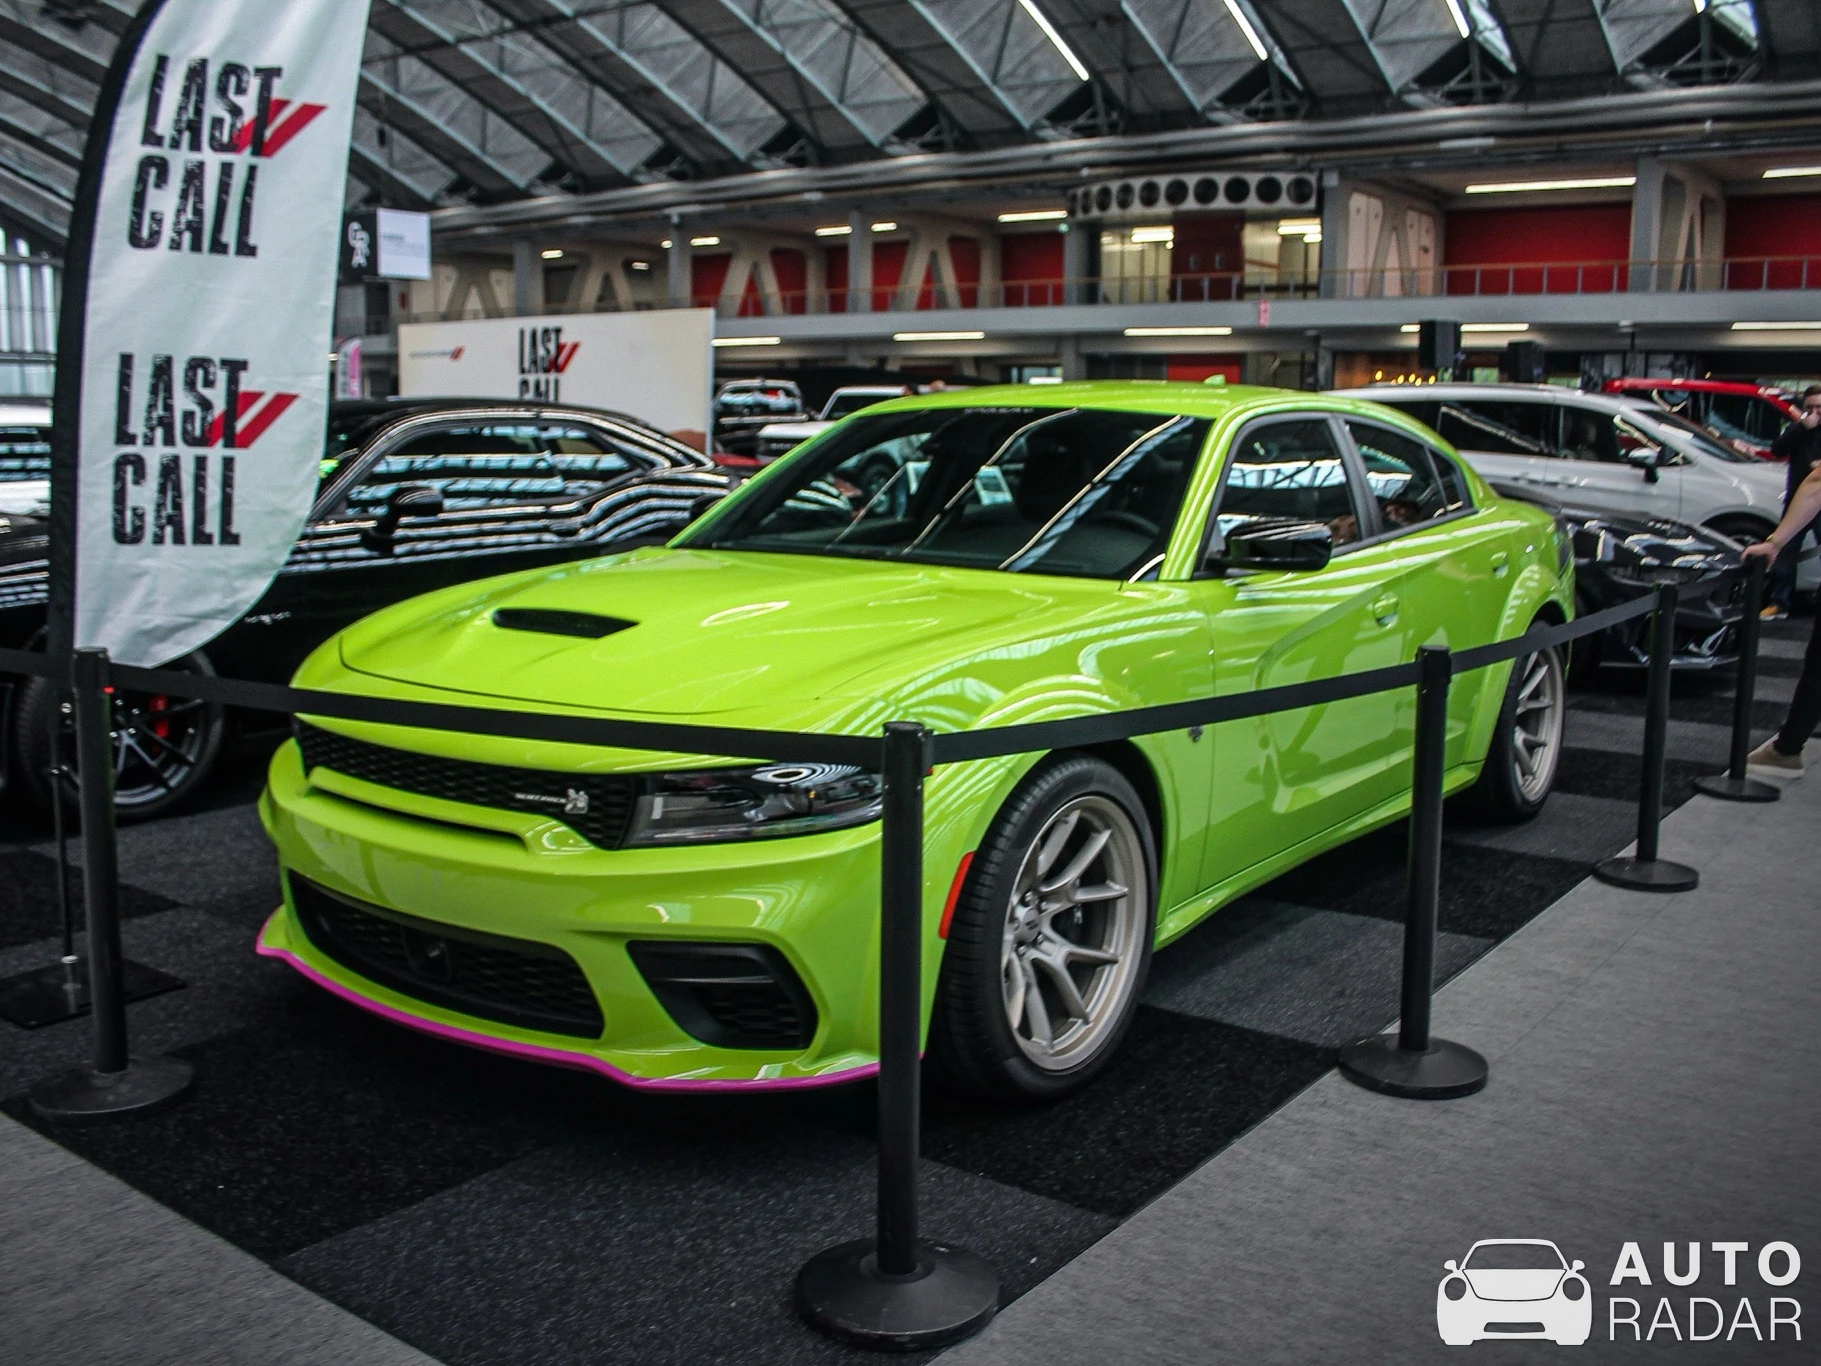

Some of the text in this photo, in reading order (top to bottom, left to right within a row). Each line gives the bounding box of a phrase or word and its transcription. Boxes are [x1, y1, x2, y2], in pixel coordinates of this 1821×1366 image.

[139, 54, 283, 157] LAST
[128, 155, 259, 257] CALL
[519, 327, 562, 374] LAST
[113, 353, 249, 448] LAST
[112, 452, 240, 546] CALL
